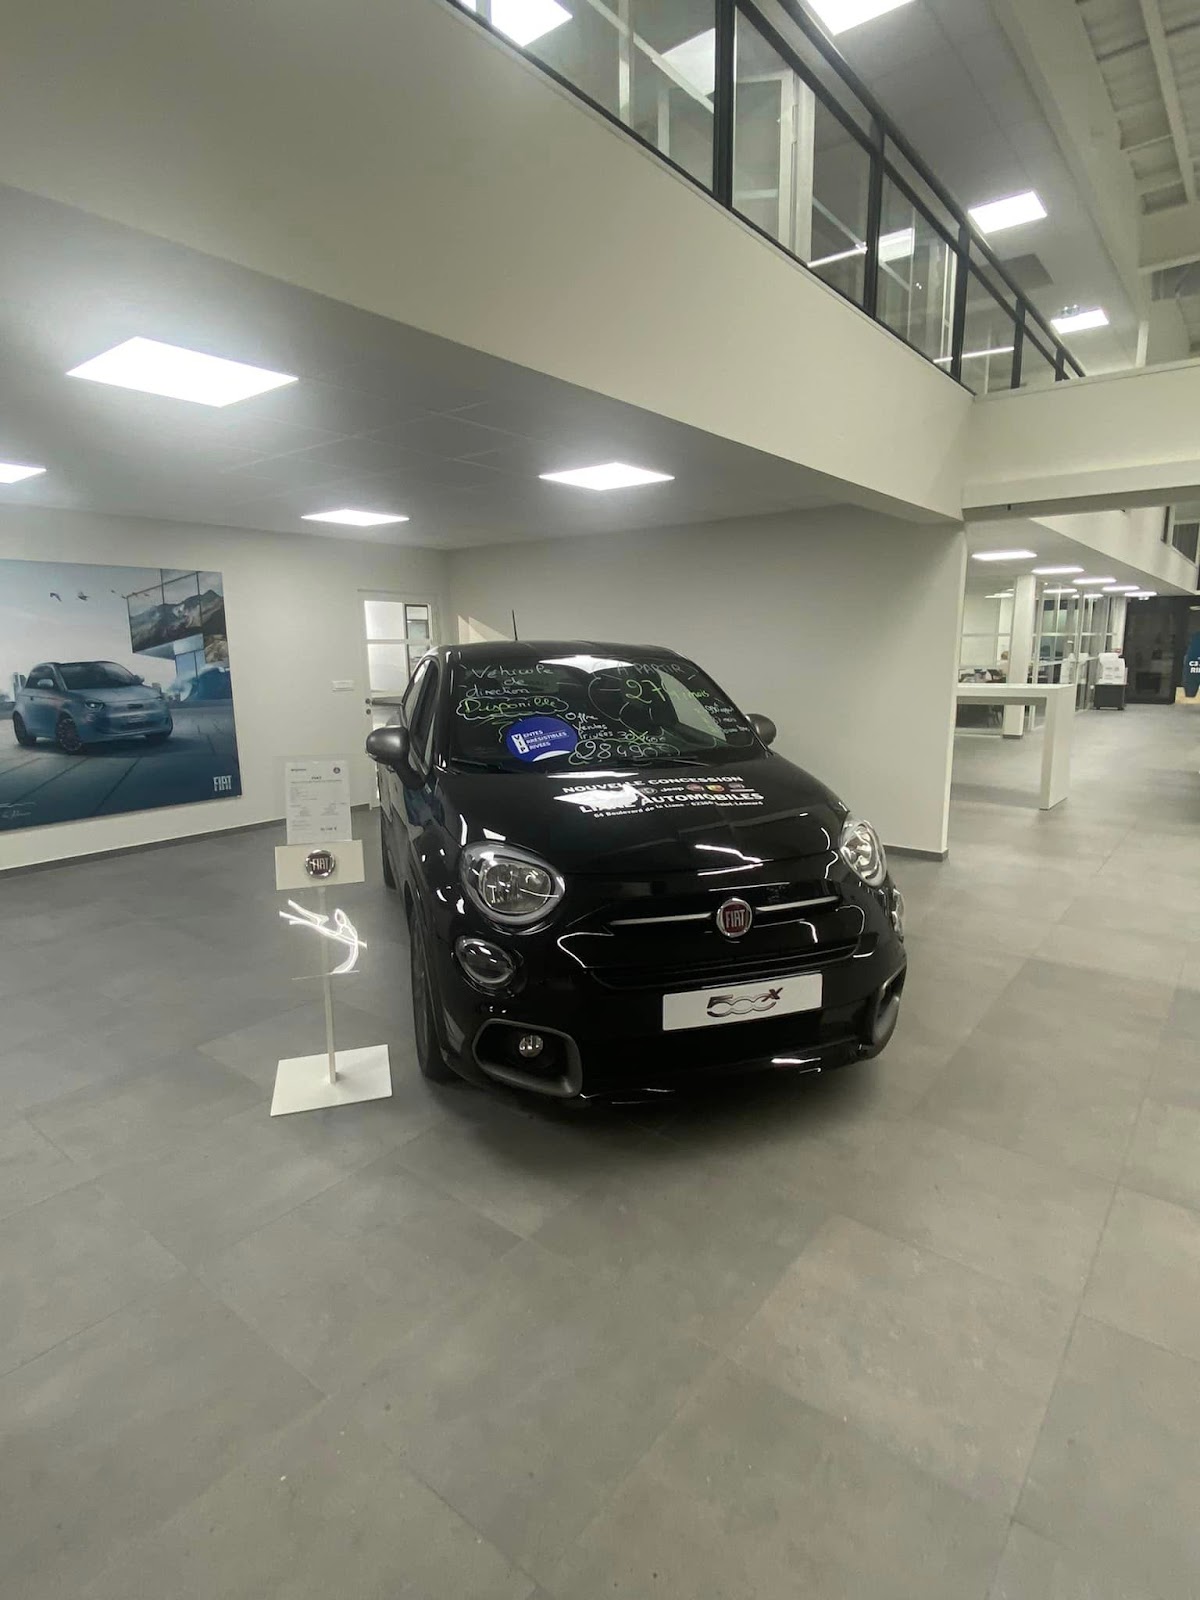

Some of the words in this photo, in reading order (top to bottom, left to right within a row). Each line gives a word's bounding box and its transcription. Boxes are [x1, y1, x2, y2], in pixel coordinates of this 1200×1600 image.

[503, 677, 528, 686] de
[466, 684, 530, 698] direction
[464, 698, 556, 714] Disponible
[213, 775, 232, 792] FIAT
[562, 780, 646, 793] NOUVELLE
[648, 776, 744, 786] CONCESSION
[641, 793, 764, 807] AUTOMOBILES
[725, 909, 746, 928] FIAT
